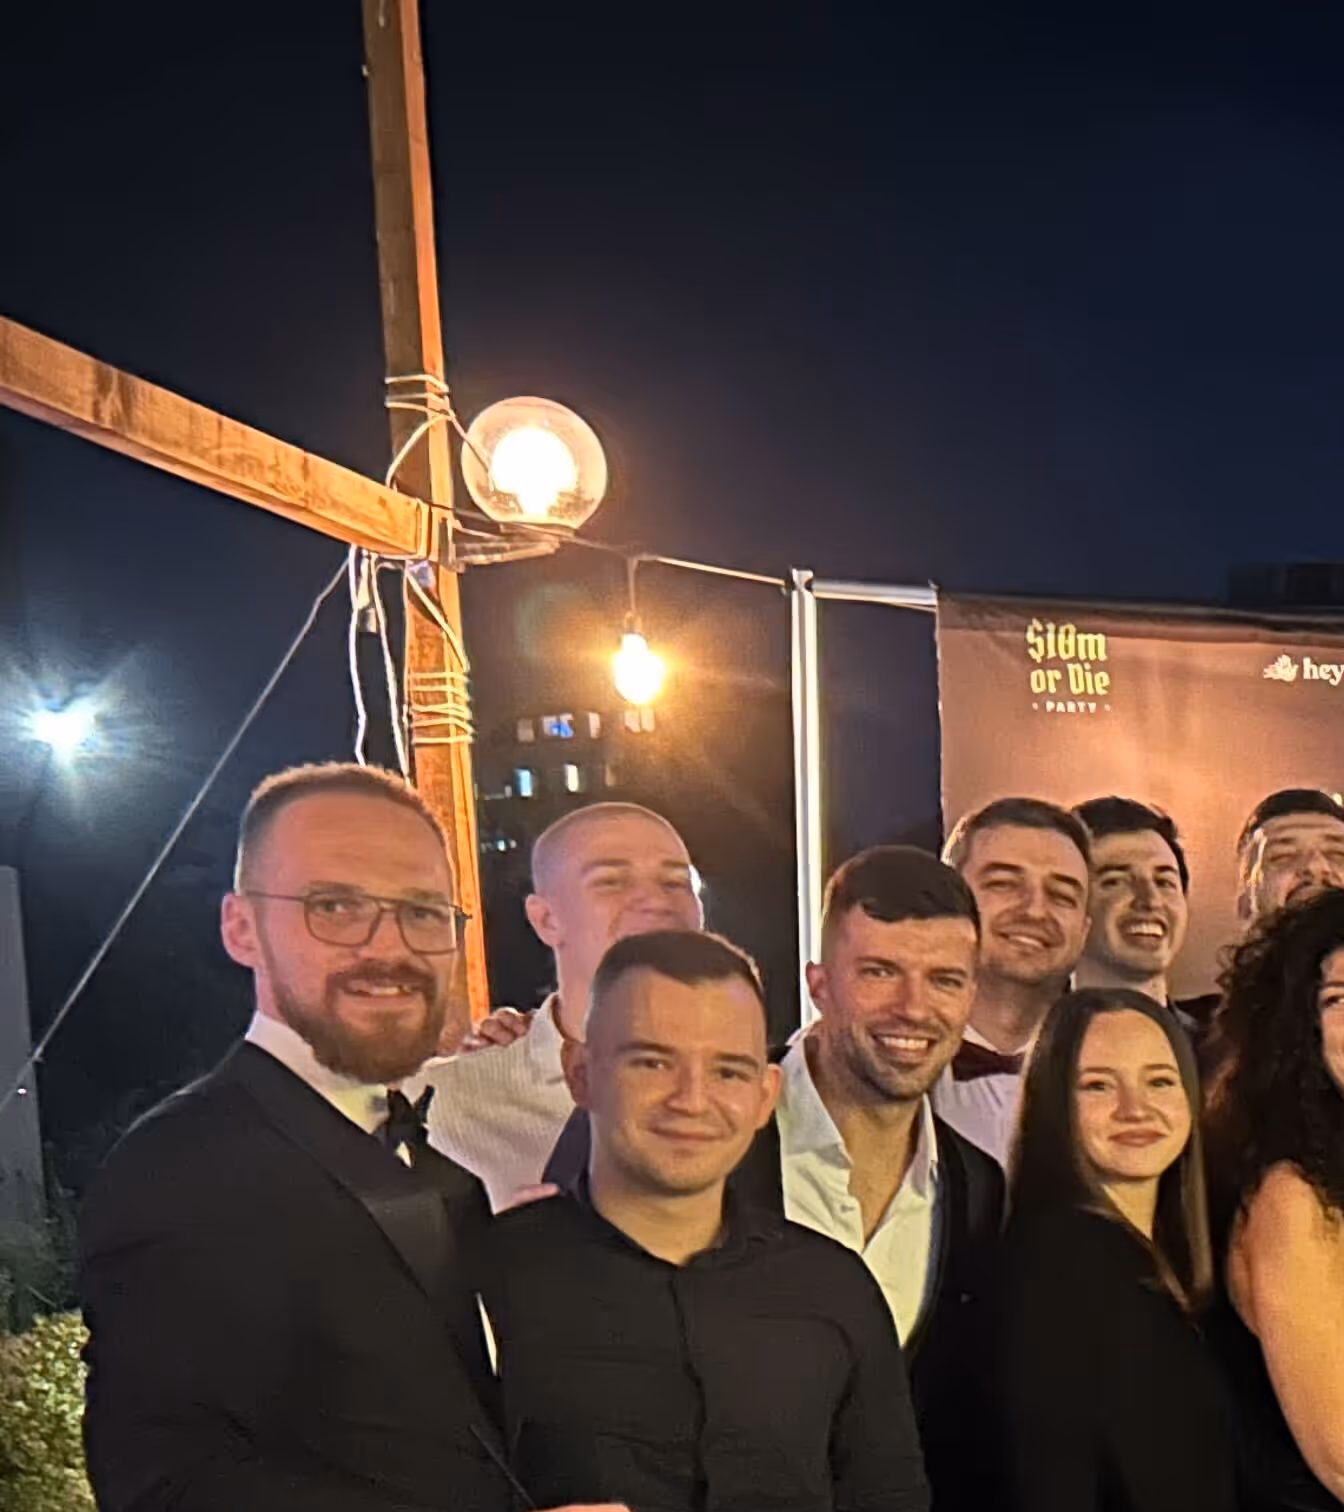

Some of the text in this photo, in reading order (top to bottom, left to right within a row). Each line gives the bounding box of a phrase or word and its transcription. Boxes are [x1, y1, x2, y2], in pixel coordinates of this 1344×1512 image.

[1026, 618, 1107, 663] $10m
[1030, 662, 1110, 695] or Die
[1046, 701, 1097, 713] PARTY
